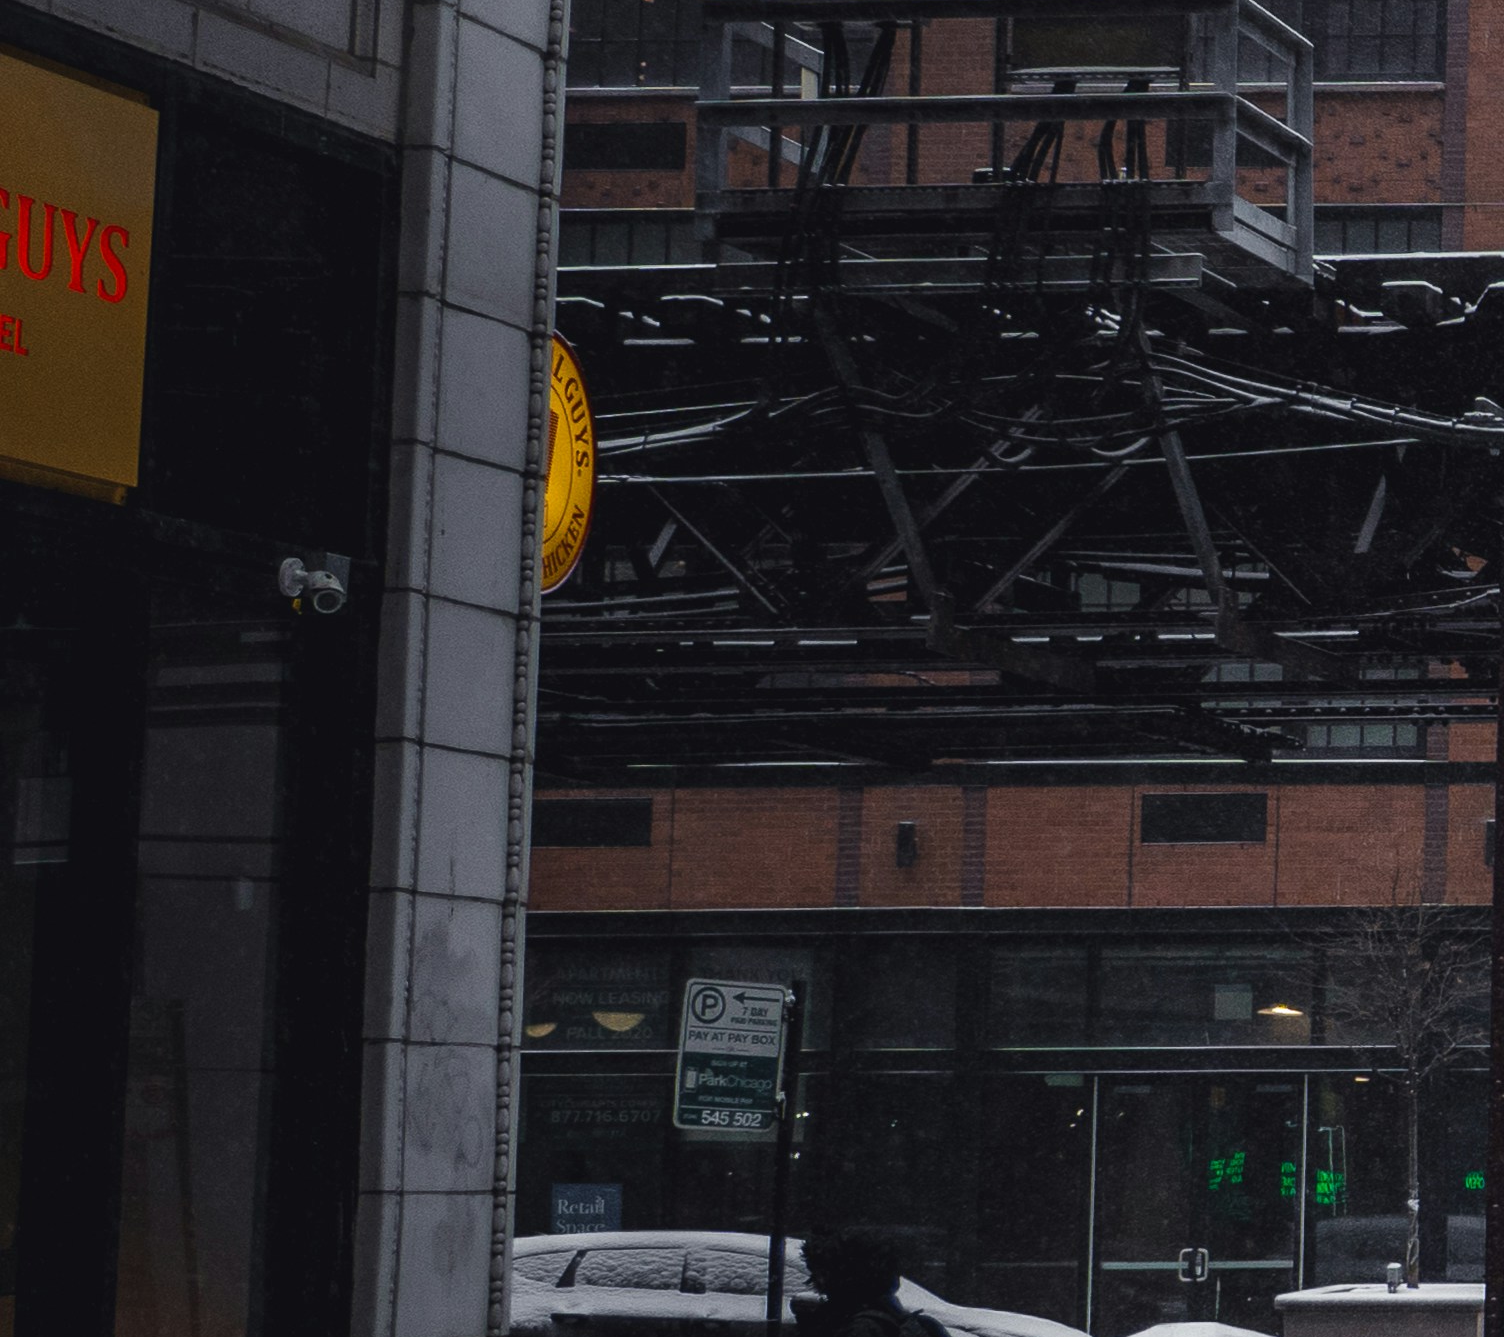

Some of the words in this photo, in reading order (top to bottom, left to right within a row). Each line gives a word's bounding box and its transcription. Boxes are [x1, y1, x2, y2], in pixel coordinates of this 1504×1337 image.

[688, 1030, 709, 1041] PAY
[711, 1032, 726, 1042] AT
[728, 1034, 749, 1044] PAY
[751, 1035, 775, 1046] BOX
[699, 1073, 773, 1090] ParkChicago
[701, 1111, 730, 1125] 545
[733, 1113, 762, 1127] 502
